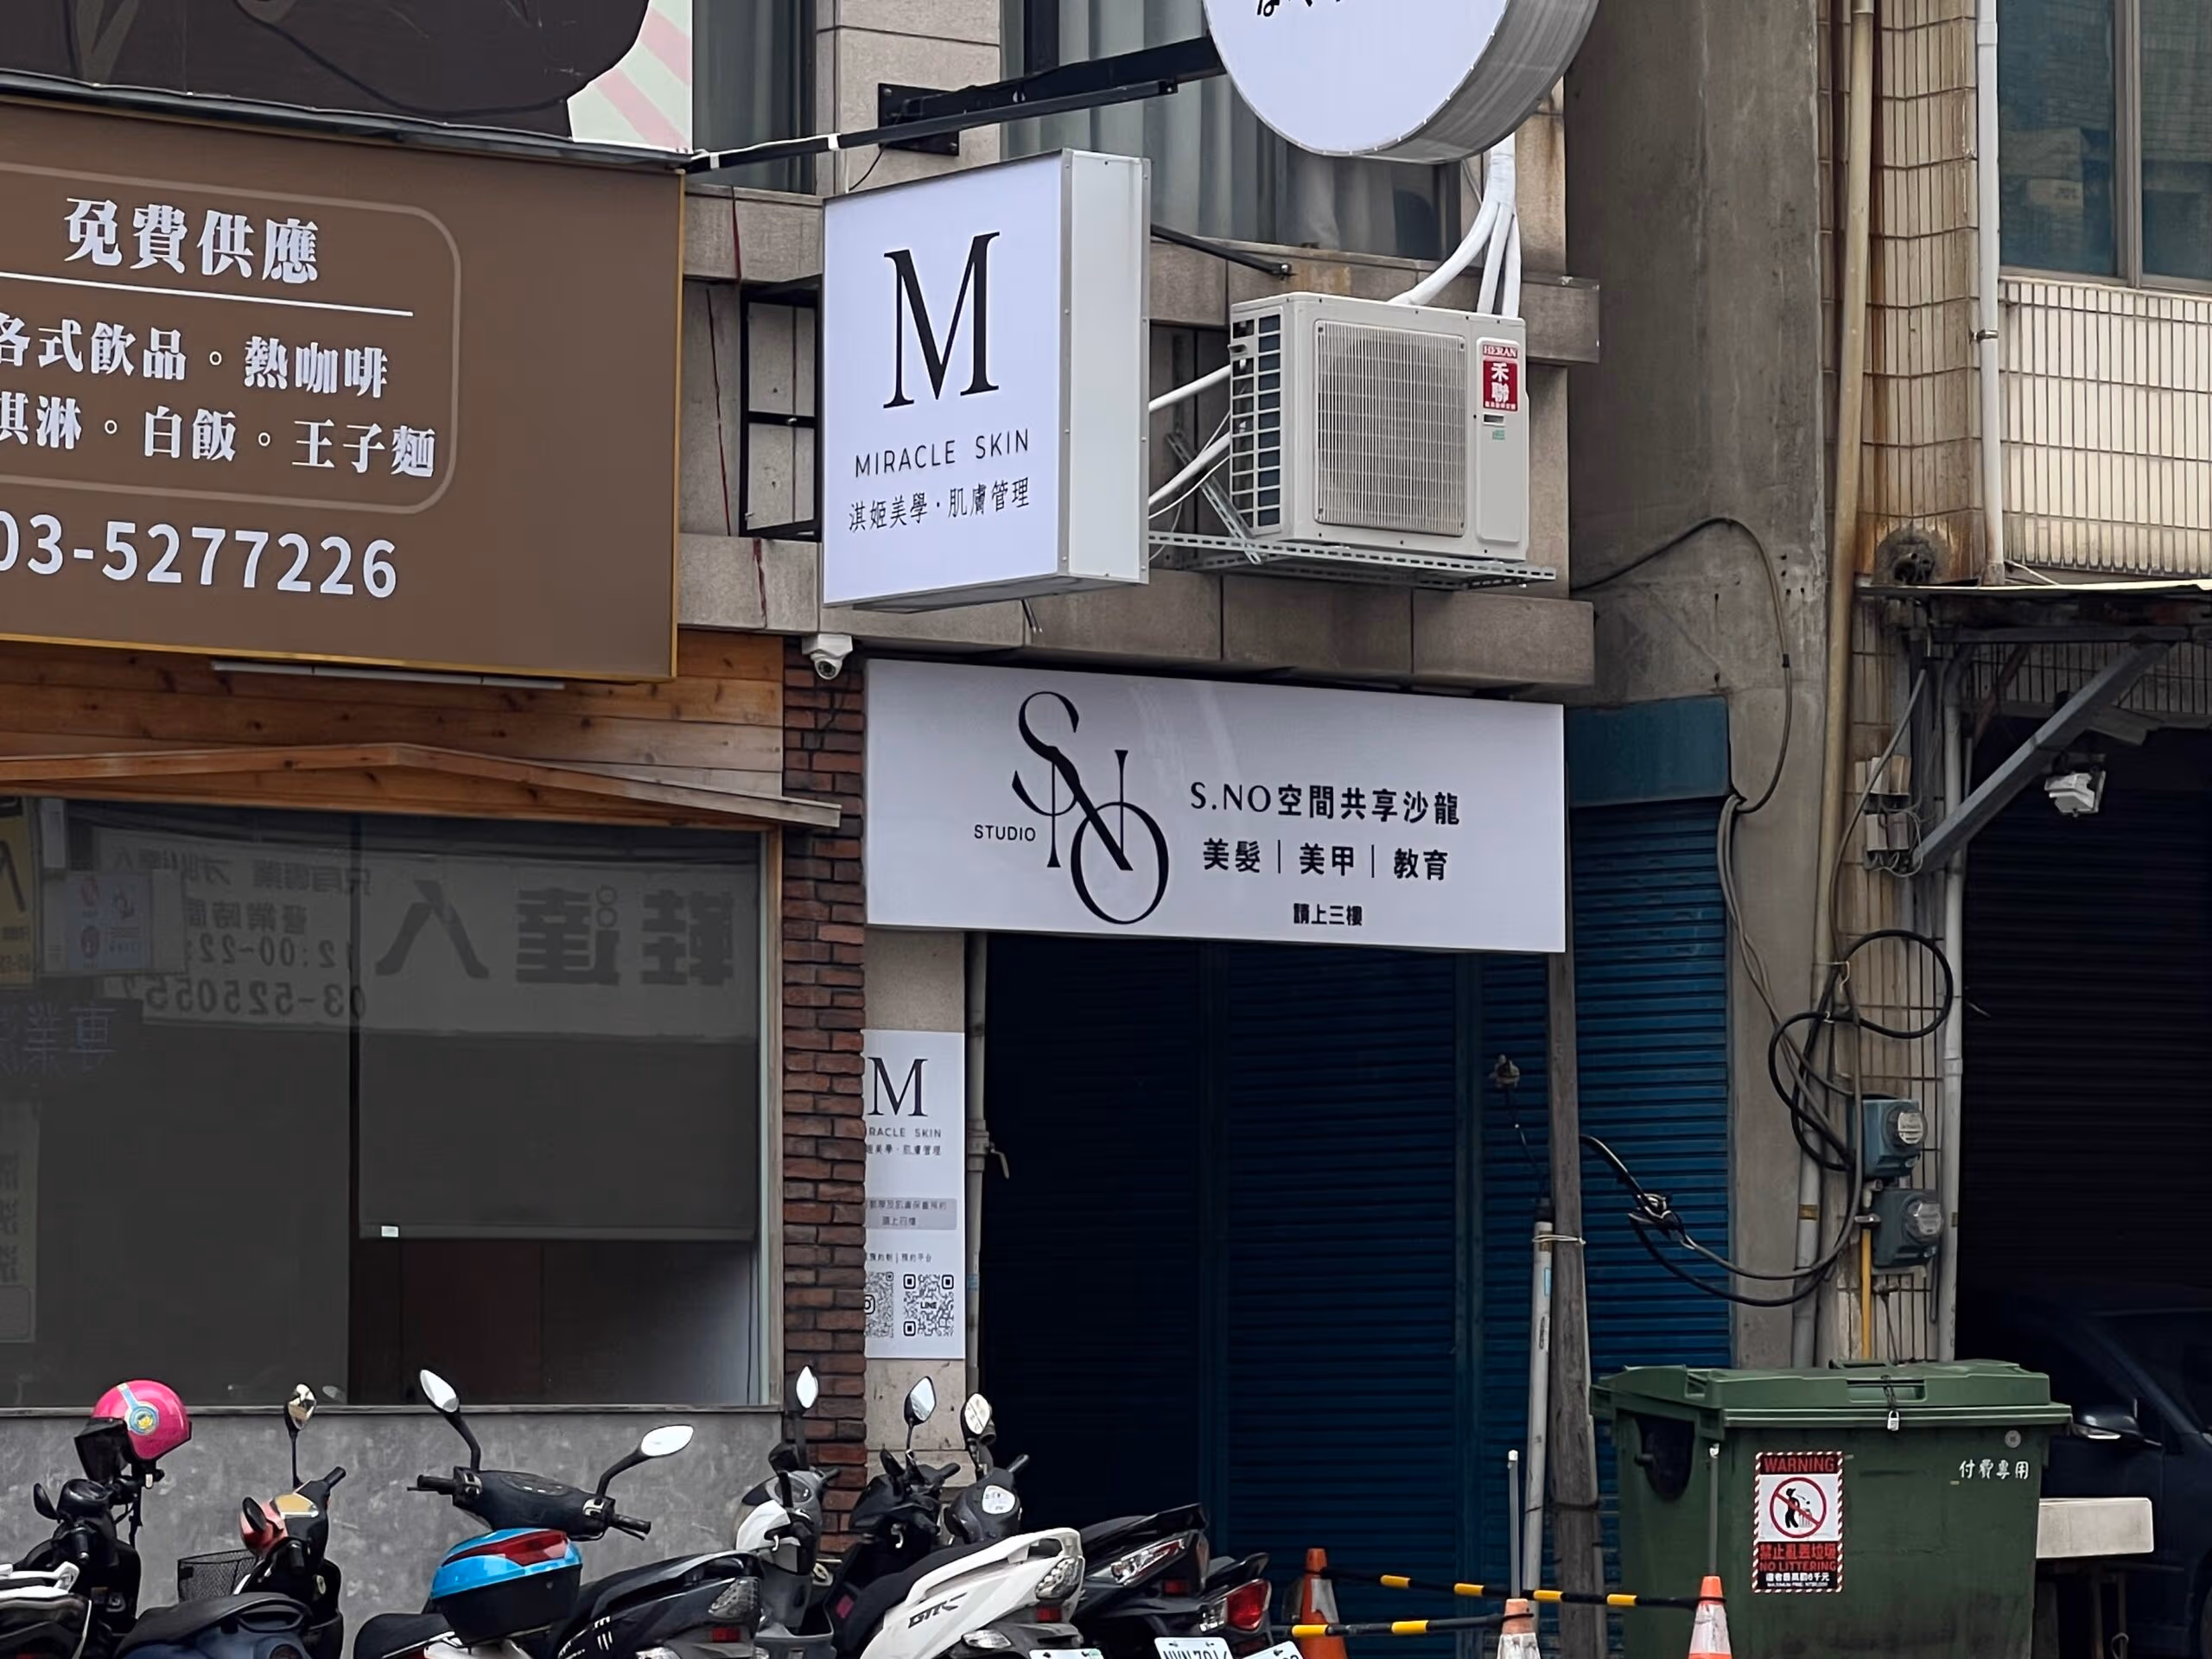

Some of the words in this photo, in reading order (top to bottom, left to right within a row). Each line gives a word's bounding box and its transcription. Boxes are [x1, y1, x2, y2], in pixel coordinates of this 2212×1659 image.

[63, 197, 320, 285] 免費供應
[883, 231, 1001, 410] M
[1484, 345, 1517, 358] HERAN
[855, 439, 956, 478] MIRACLE
[975, 428, 1029, 460] SKIN
[0, 510, 398, 598] 03-5277226
[974, 823, 1036, 842] STUDIO
[1294, 902, 1363, 926] 請上三樓
[867, 1056, 930, 1117] M
[868, 1127, 906, 1137] RACLE
[914, 1128, 942, 1138] SKIN
[1764, 1457, 1835, 1473] WARNING
[1759, 1560, 1777, 1572] NO
[1778, 1560, 1837, 1572] LITTERING
